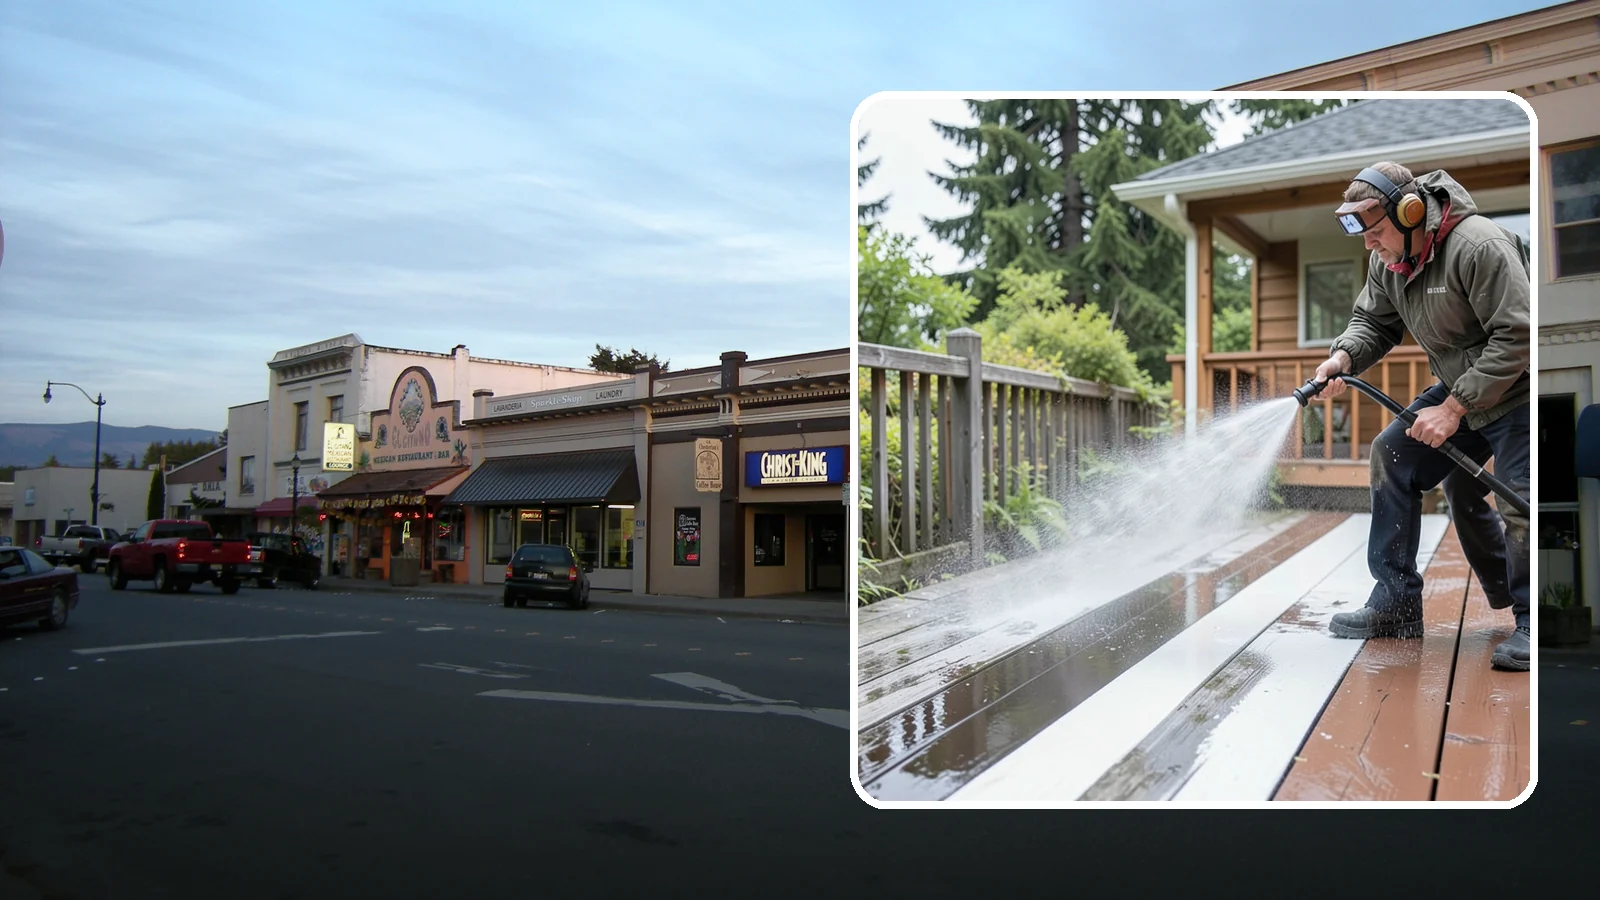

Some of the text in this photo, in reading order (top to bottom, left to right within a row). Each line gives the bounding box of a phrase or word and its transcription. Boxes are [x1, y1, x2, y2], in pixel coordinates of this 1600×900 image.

[562, 394, 583, 404] Shop
[595, 389, 624, 400] LAUNDRY
[493, 402, 522, 413] LAVANDERIA
[374, 455, 396, 464] MEXICAN
[397, 451, 433, 462] RESTAURANT
[437, 450, 450, 459] BAR
[761, 450, 827, 478] CHRIST KING
